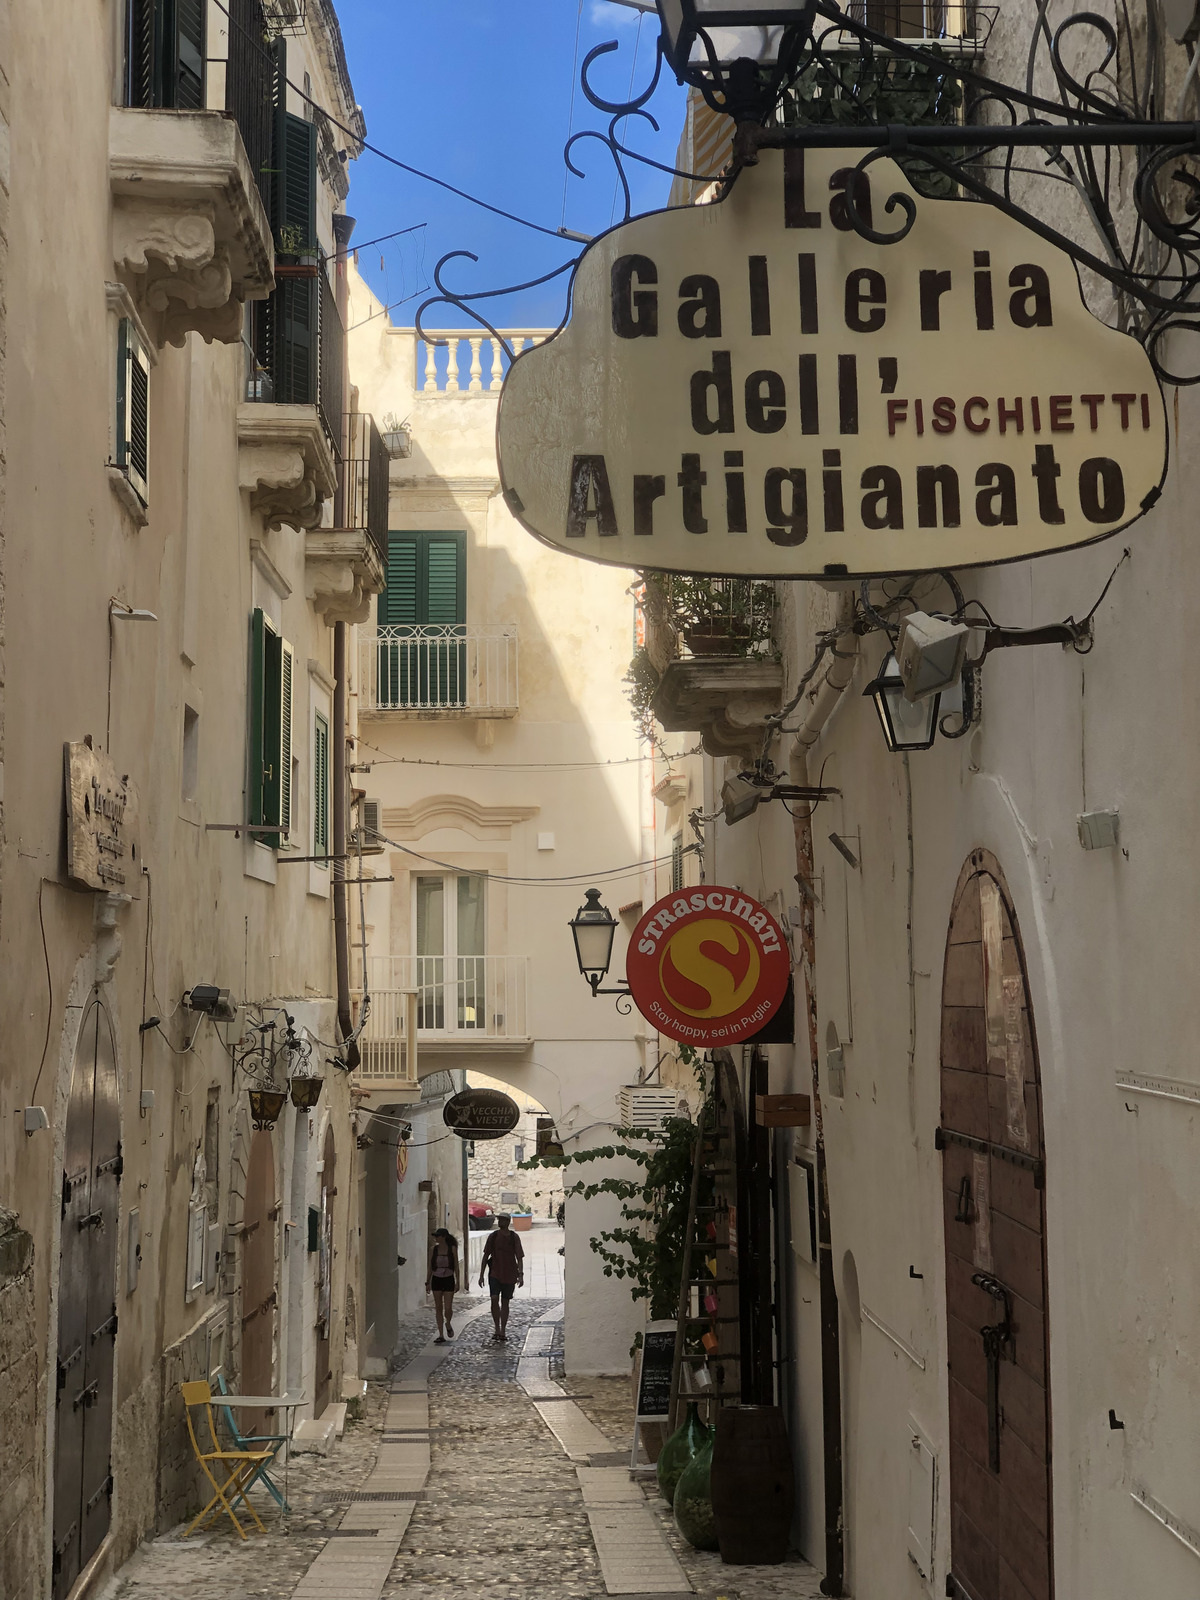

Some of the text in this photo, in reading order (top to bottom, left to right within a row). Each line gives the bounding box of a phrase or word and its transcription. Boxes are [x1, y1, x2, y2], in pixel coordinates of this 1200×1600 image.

[783, 148, 873, 231] La
[610, 251, 1053, 339] Galleria
[690, 350, 898, 435] dell'
[887, 393, 1152, 436] FISCHIETTI
[565, 444, 1126, 547] Artigianato
[649, 1000, 772, 1040] Stay happy, sei in Puglia
[473, 1106, 514, 1115] VECCHIA
[476, 1116, 511, 1125] VIESTE
